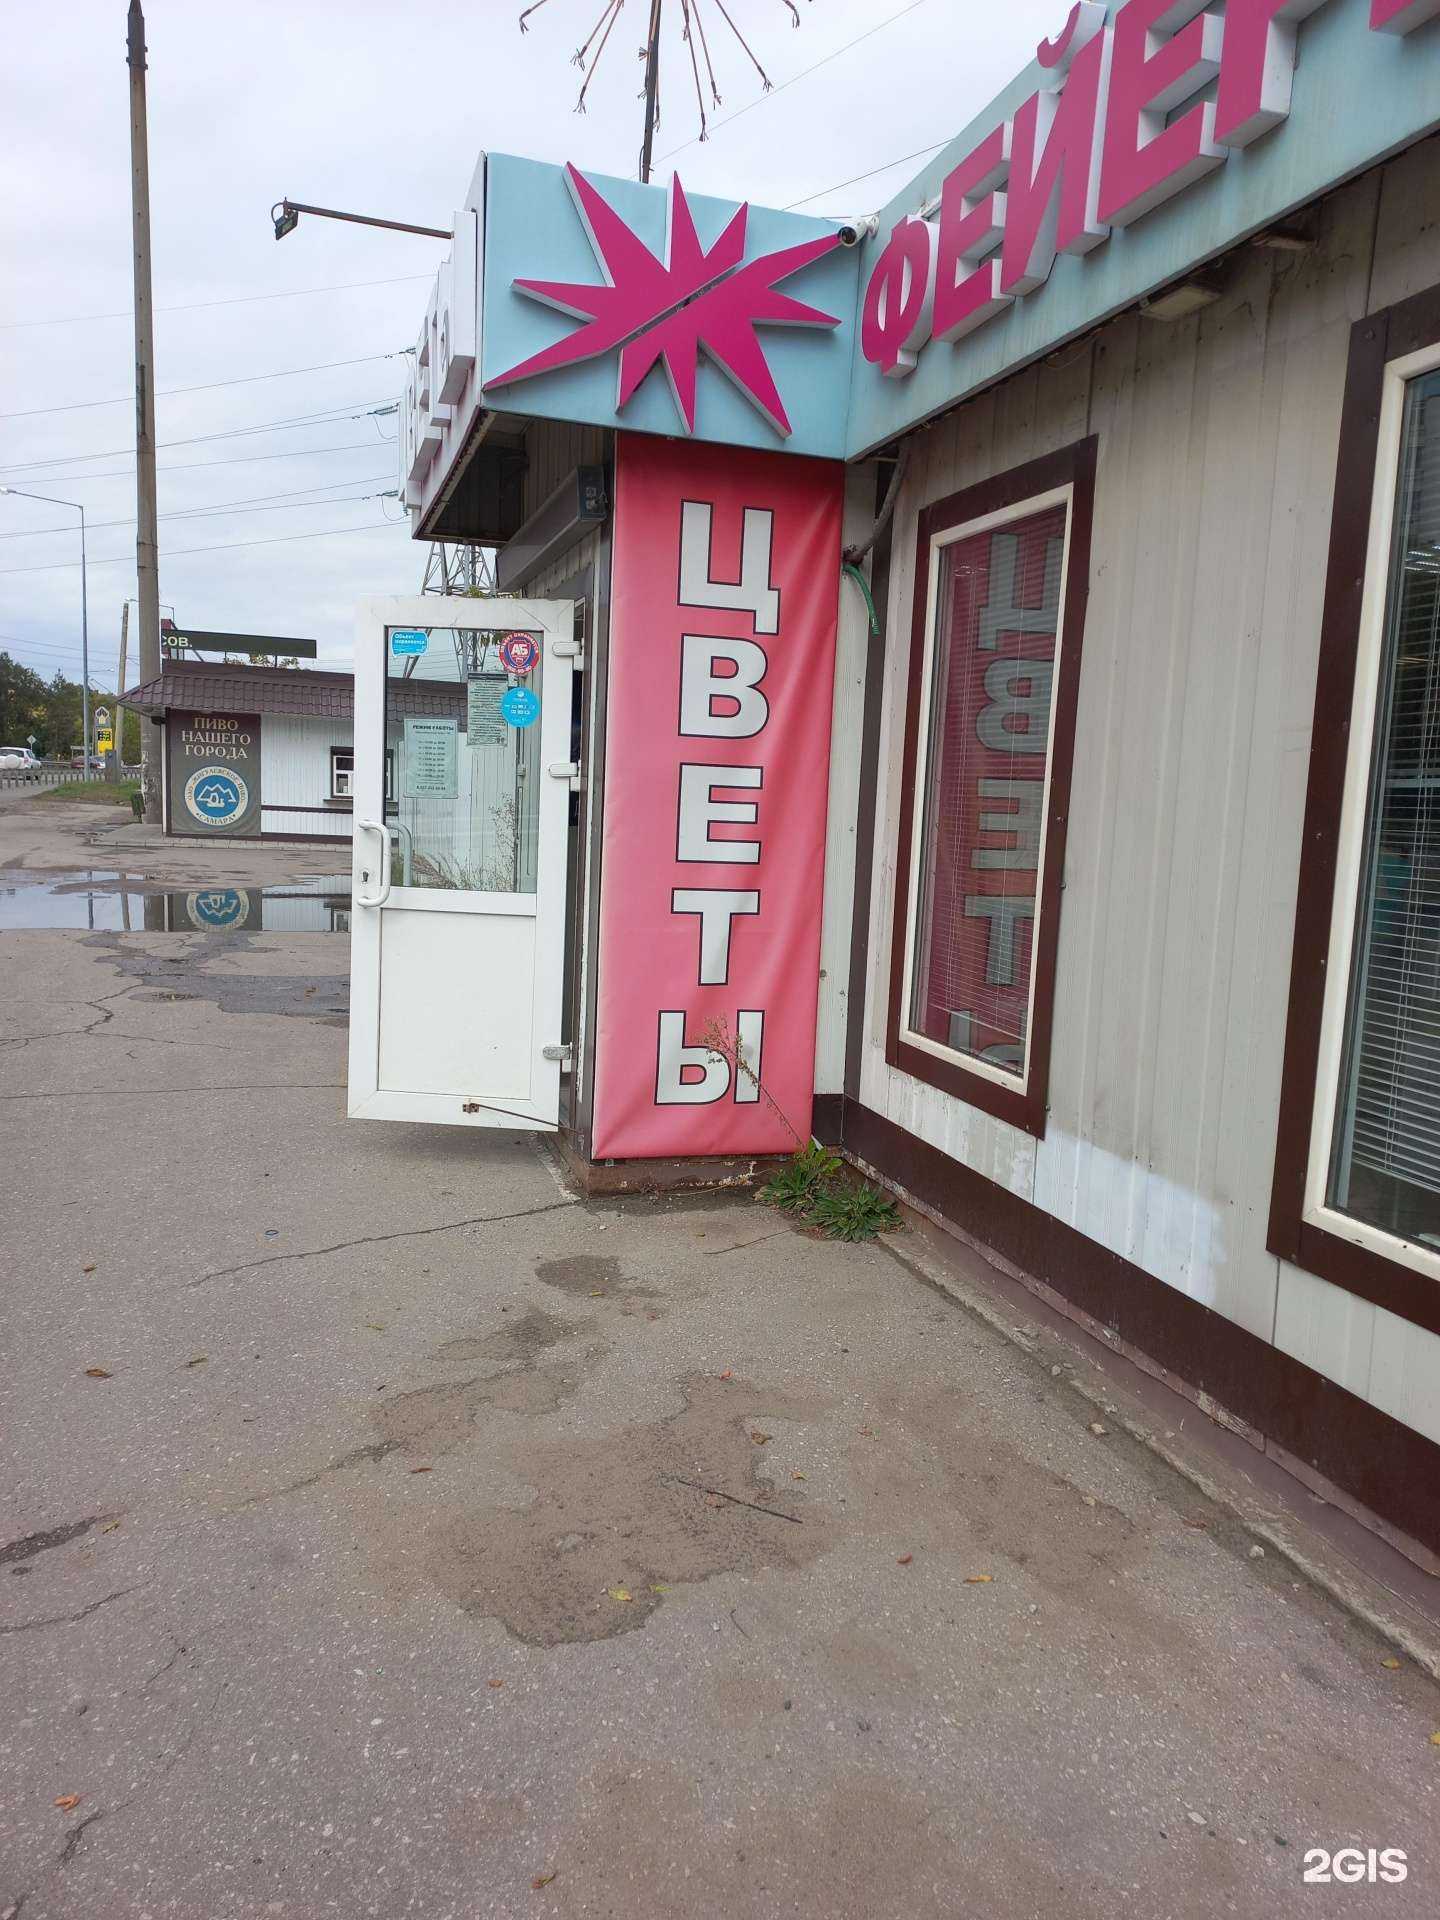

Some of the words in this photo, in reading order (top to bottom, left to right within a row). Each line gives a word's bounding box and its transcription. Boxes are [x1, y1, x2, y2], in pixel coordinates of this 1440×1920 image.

[194, 717, 239, 731] ПИВО
[181, 730, 251, 745] НАШЕГО
[184, 744, 248, 760] ГОРОДА
[654, 499, 780, 1106] ЦВЕТЫ
